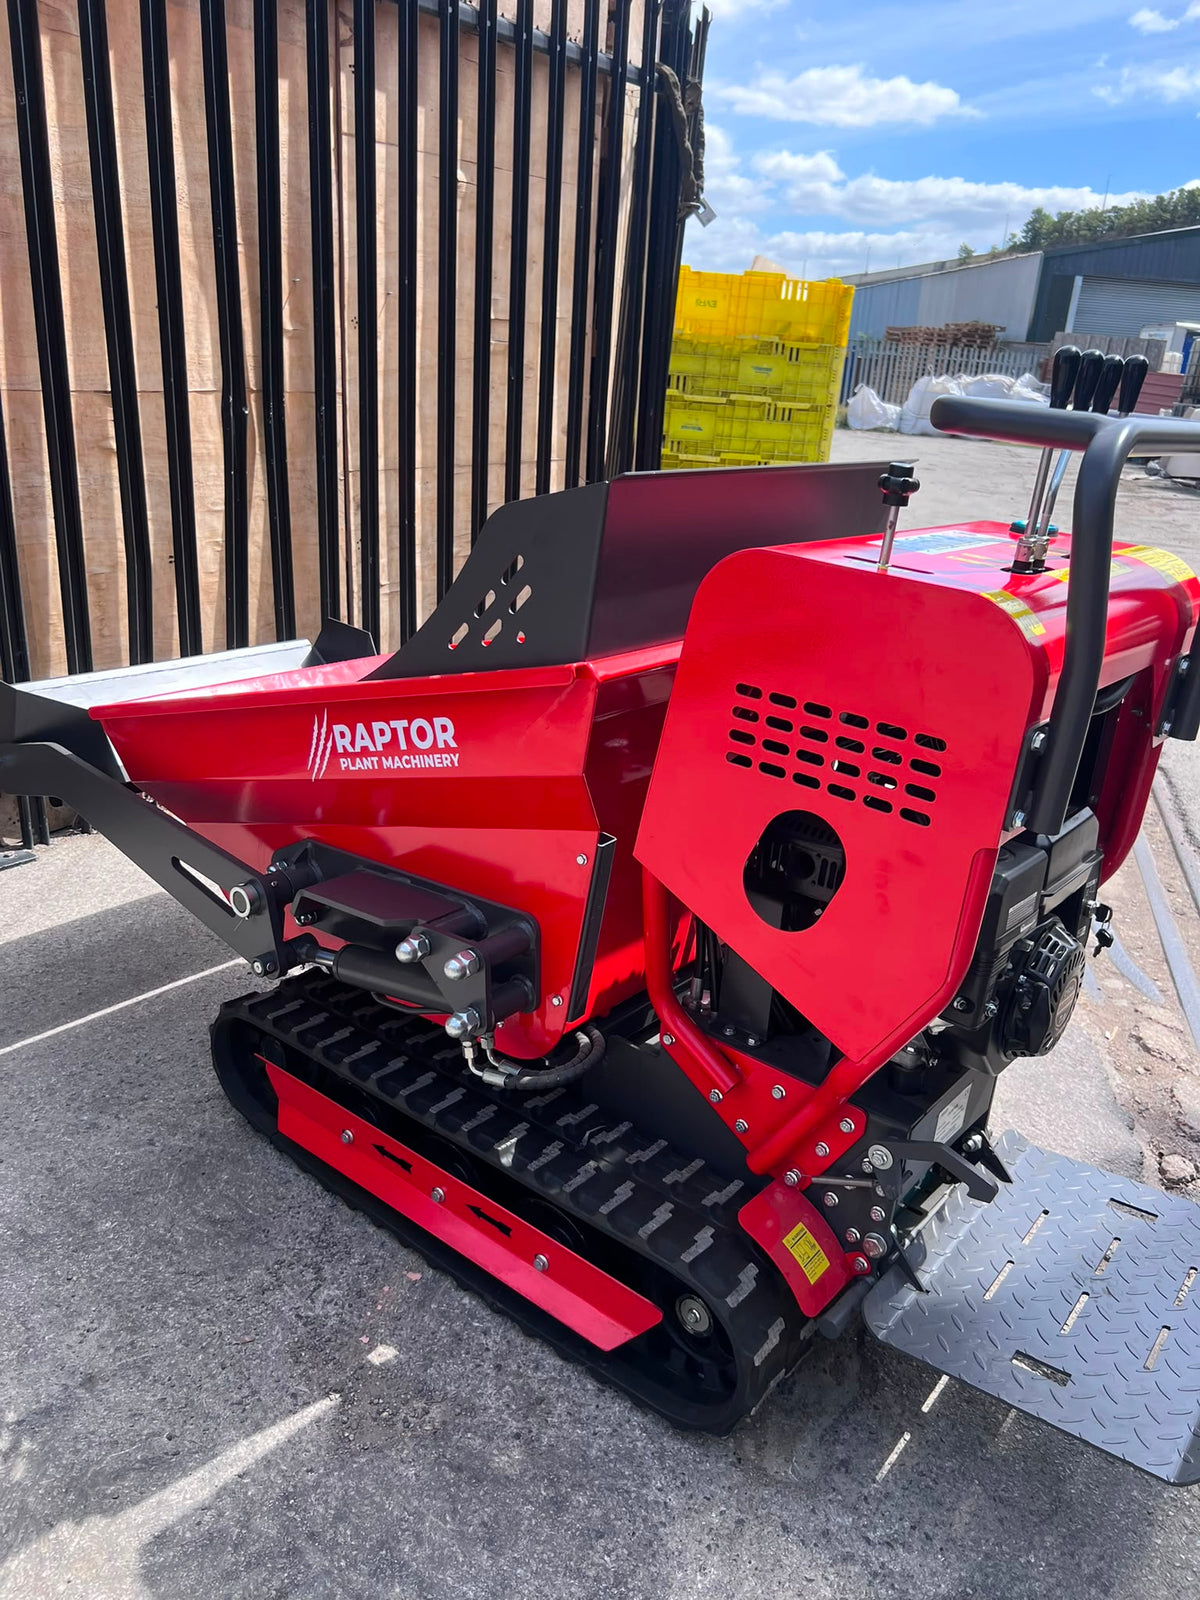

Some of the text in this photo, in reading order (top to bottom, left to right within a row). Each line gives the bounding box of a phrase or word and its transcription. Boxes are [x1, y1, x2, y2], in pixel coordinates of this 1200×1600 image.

[332, 717, 458, 753] RAPTOR
[340, 753, 459, 770] PLANT MACHINERY
